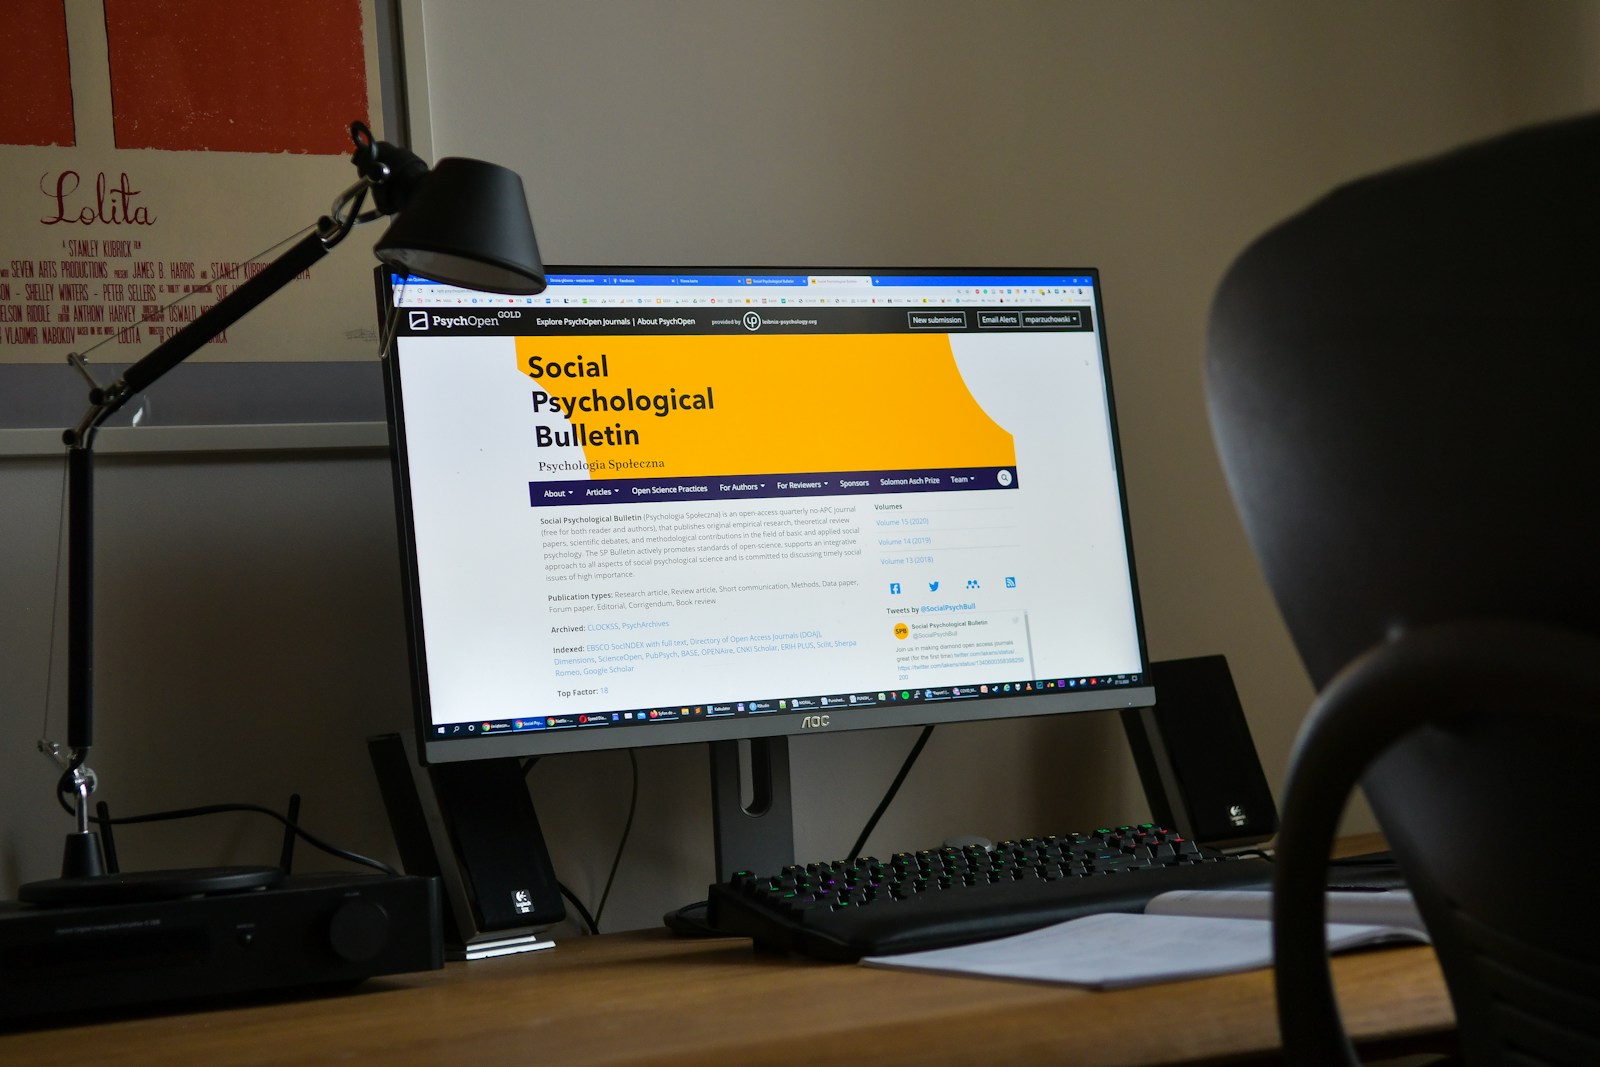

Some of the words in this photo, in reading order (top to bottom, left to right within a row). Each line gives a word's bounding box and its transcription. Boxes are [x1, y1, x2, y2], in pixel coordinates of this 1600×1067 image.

[40, 170, 157, 226] Lolita
[69, 239, 99, 258] STANLEY
[103, 240, 132, 258] KUBRICK
[11, 260, 34, 278] SEVEN
[38, 260, 57, 278] ARTS
[61, 261, 108, 279] PRODUCTIONS
[132, 261, 155, 279] JAMES
[170, 261, 195, 280] HARRIS
[211, 262, 240, 280] STANLEY
[25, 283, 54, 301] SHELLEY
[59, 284, 88, 301] WINTERS
[103, 284, 124, 302] PETER
[128, 284, 157, 302] SELLERS
[0, 305, 22, 322] ELSON
[27, 305, 51, 322] RIDDLE
[73, 305, 104, 322] ANTHONY
[109, 305, 135, 322] HARVEY
[169, 305, 197, 322] OSWALD
[432, 315, 498, 328] PsychOpen
[497, 310, 521, 318] GOLD
[981, 315, 999, 323] Email
[999, 315, 1017, 323] Alerts
[1025, 315, 1070, 324] mparzuchowski
[536, 317, 563, 327] Explore
[563, 317, 602, 327] PsychOpen
[602, 317, 631, 326] Journals
[636, 317, 658, 325] About
[658, 317, 695, 326] PsychOpen
[5, 327, 38, 344] VLADIMIR
[42, 327, 75, 344] NABOKOV
[118, 327, 141, 344] LOLITA
[528, 354, 608, 378] Social
[531, 386, 714, 419] Psychological
[535, 422, 639, 447] Bulletin
[538, 459, 605, 473] Psychologia
[608, 458, 664, 471] Społeczna
[776, 481, 788, 489] For
[839, 479, 869, 488] Sponsors
[924, 476, 940, 484] Prize
[950, 475, 968, 483] Team
[543, 489, 566, 497] About
[585, 487, 612, 496] Articles
[631, 486, 651, 496] Open
[651, 486, 677, 494] Science
[677, 484, 708, 492] Practices
[719, 483, 731, 491] For
[563, 515, 612, 525] Psychological
[613, 514, 642, 522] Bulletin
[643, 513, 684, 522] (Psychologia
[685, 511, 721, 519] Społeczna)
[738, 510, 778, 518] open-access
[779, 508, 808, 516] quarterly
[833, 505, 855, 514] journal
[909, 517, 929, 525] (2020)
[540, 528, 558, 537] (free
[570, 527, 588, 535] both
[588, 526, 611, 534] reader
[612, 525, 626, 533] and
[627, 524, 657, 532] authors),
[673, 523, 705, 532] publishes
[706, 521, 731, 530] original
[732, 520, 762, 529] empirical
[793, 517, 827, 525] theoretical
[911, 536, 931, 544] (2019)
[913, 555, 934, 564] (2018)
[568, 572, 576, 580] of
[577, 572, 592, 581] high
[547, 593, 589, 601] Publication
[590, 592, 613, 601] types:
[614, 589, 645, 598] Research
[737, 583, 789, 591] communication,
[791, 580, 820, 588] Methods,
[573, 605, 595, 613] paper,
[596, 602, 627, 610] Editorial,
[628, 600, 674, 609] Corrigendum,
[675, 598, 693, 606] Book
[920, 602, 976, 612] @SocialPsychBull
[550, 624, 585, 633] Archived:
[587, 622, 620, 631] CLOCKSS,
[621, 620, 669, 630] PsychArchives
[929, 620, 966, 629] Psychological
[552, 645, 585, 654] Indexed:
[586, 643, 610, 652] EBSCO
[610, 641, 644, 650] SocINDEX
[645, 640, 660, 648] with
[721, 635, 728, 643] of
[729, 635, 749, 644] Open
[772, 631, 799, 641] Journals
[553, 657, 596, 665] Dimensions,
[597, 653, 644, 662] ScienceOpen,
[645, 650, 679, 660] PubPsych,
[680, 649, 699, 657] BASE,
[700, 647, 735, 655] OPENAire,
[753, 644, 779, 652] Scholar,
[780, 642, 796, 650] ERIH
[797, 641, 815, 649] PLUS,
[834, 639, 857, 647] Sherpa
[582, 666, 608, 676] Google
[608, 664, 634, 673] Scholar
[556, 690, 571, 698] Top
